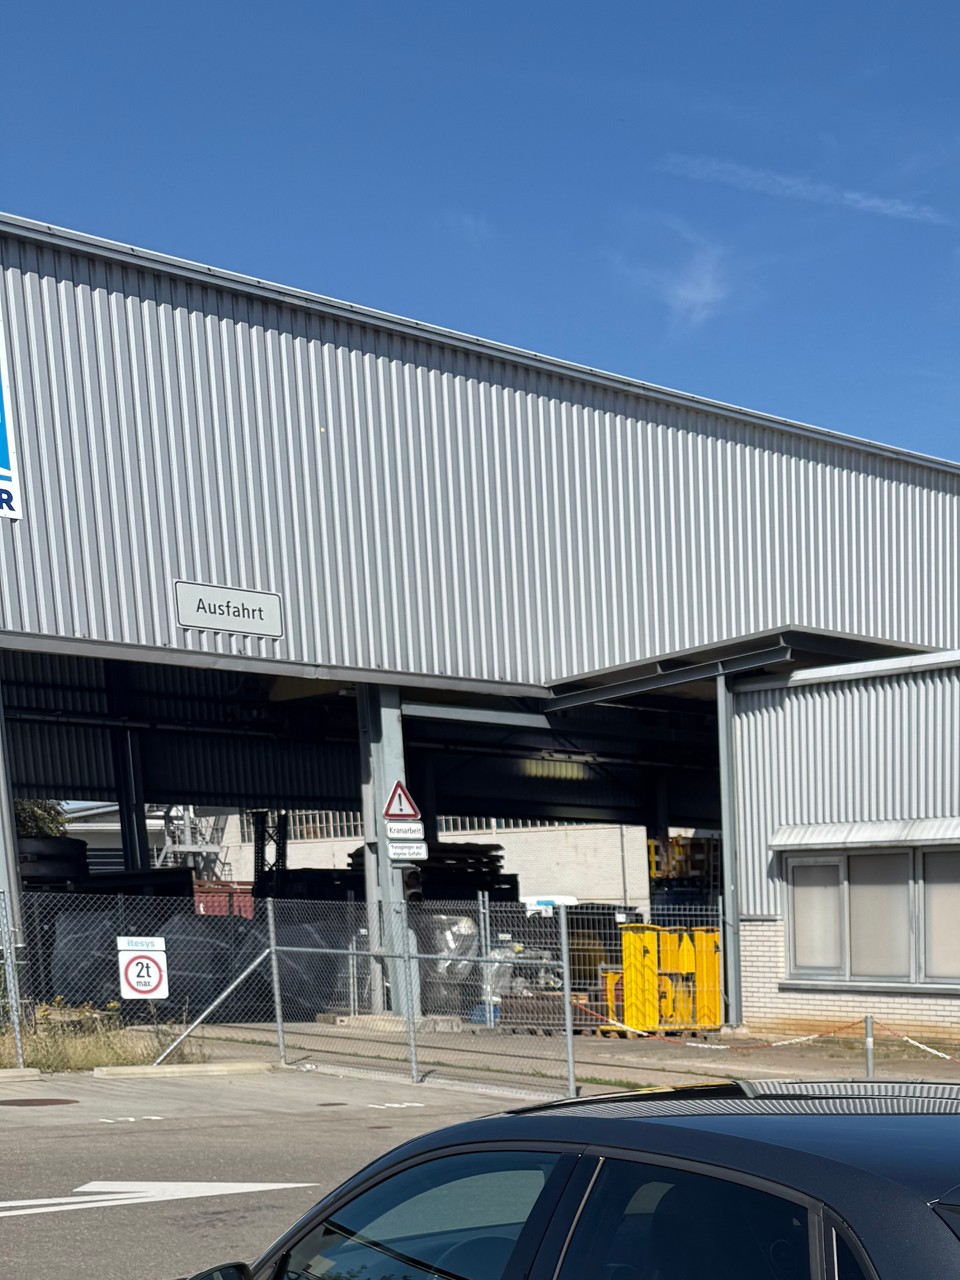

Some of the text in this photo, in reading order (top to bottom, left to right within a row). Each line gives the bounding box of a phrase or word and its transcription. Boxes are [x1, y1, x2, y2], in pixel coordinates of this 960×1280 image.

[196, 598, 265, 621] Ausfahrt
[389, 826, 422, 834] Kranarbeit
[127, 939, 155, 948] itesys
[135, 961, 152, 978] 2t
